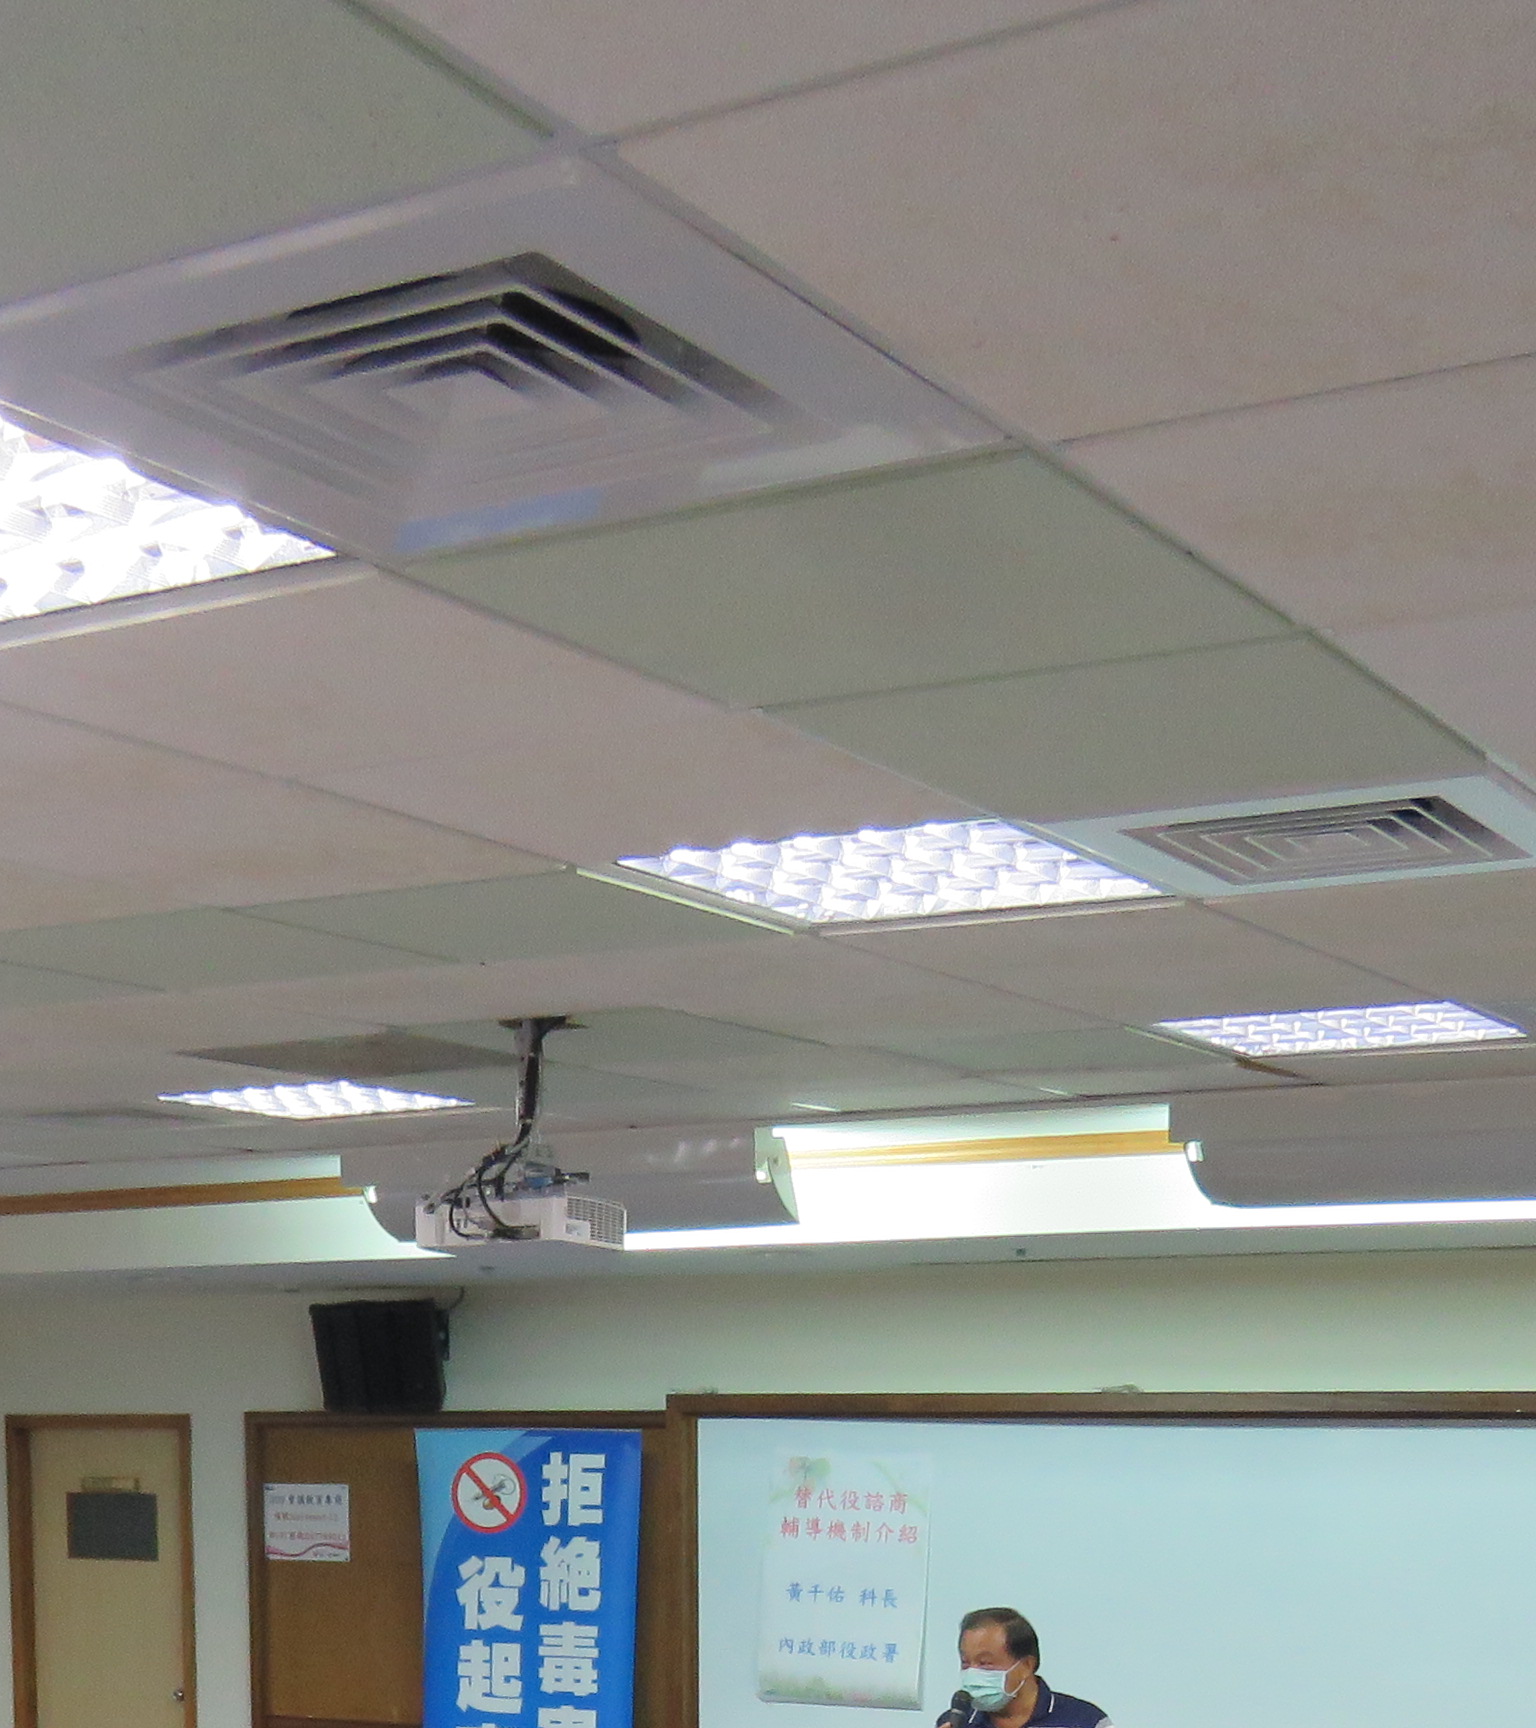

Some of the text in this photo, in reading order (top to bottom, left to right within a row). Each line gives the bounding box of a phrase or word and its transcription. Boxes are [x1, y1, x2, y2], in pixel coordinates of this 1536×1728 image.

[794, 1486, 909, 1514] 替代役諮商
[779, 1516, 920, 1545] 輔導機制介紹
[859, 1587, 899, 1609] 科長
